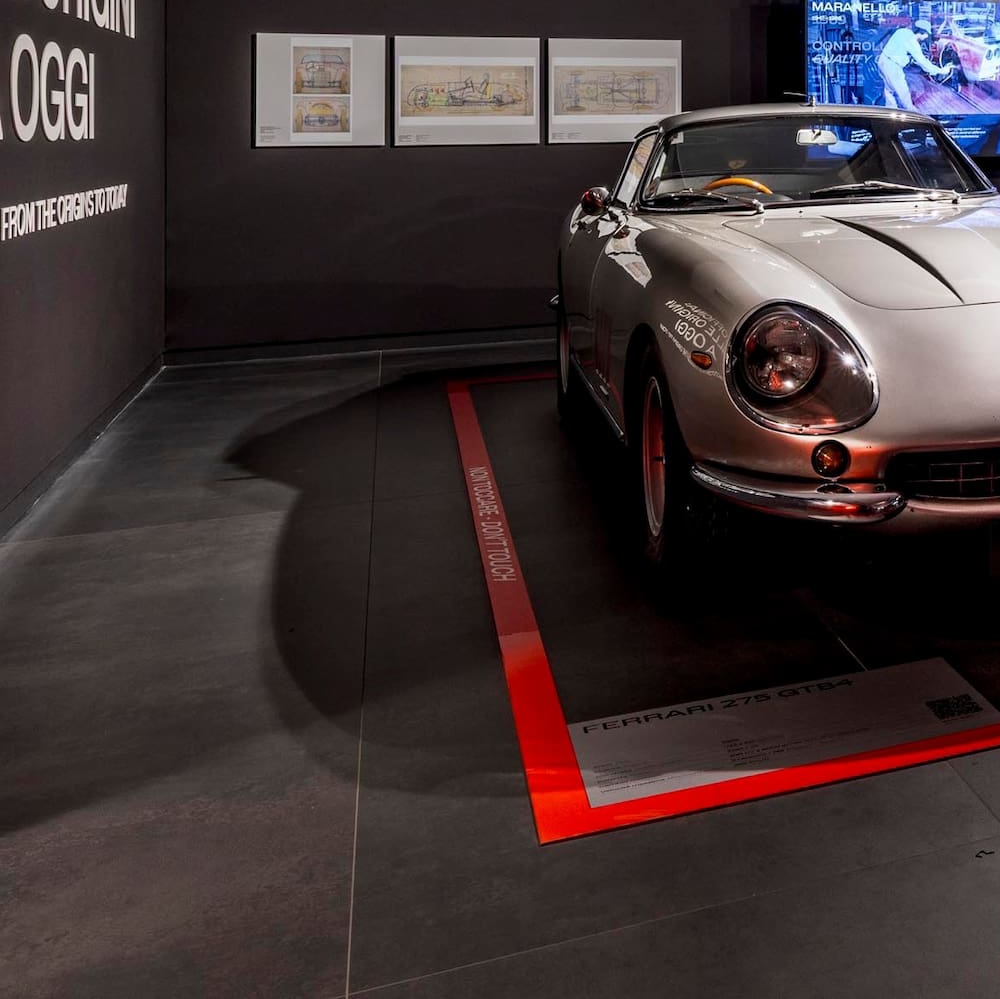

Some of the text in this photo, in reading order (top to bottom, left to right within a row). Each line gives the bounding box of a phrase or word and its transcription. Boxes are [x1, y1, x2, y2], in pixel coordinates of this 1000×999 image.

[812, 2, 896, 13] MARANELLO
[812, 54, 873, 64] QUALITY
[9, 33, 95, 142] OGGI
[1, 184, 128, 241] FROM THE ORIGINS TO TODAY
[468, 466, 490, 482] NON
[473, 481, 499, 517] TOCCARE
[487, 547, 517, 581] TOUCH
[583, 679, 854, 733] FERRARI 275 GTB4
